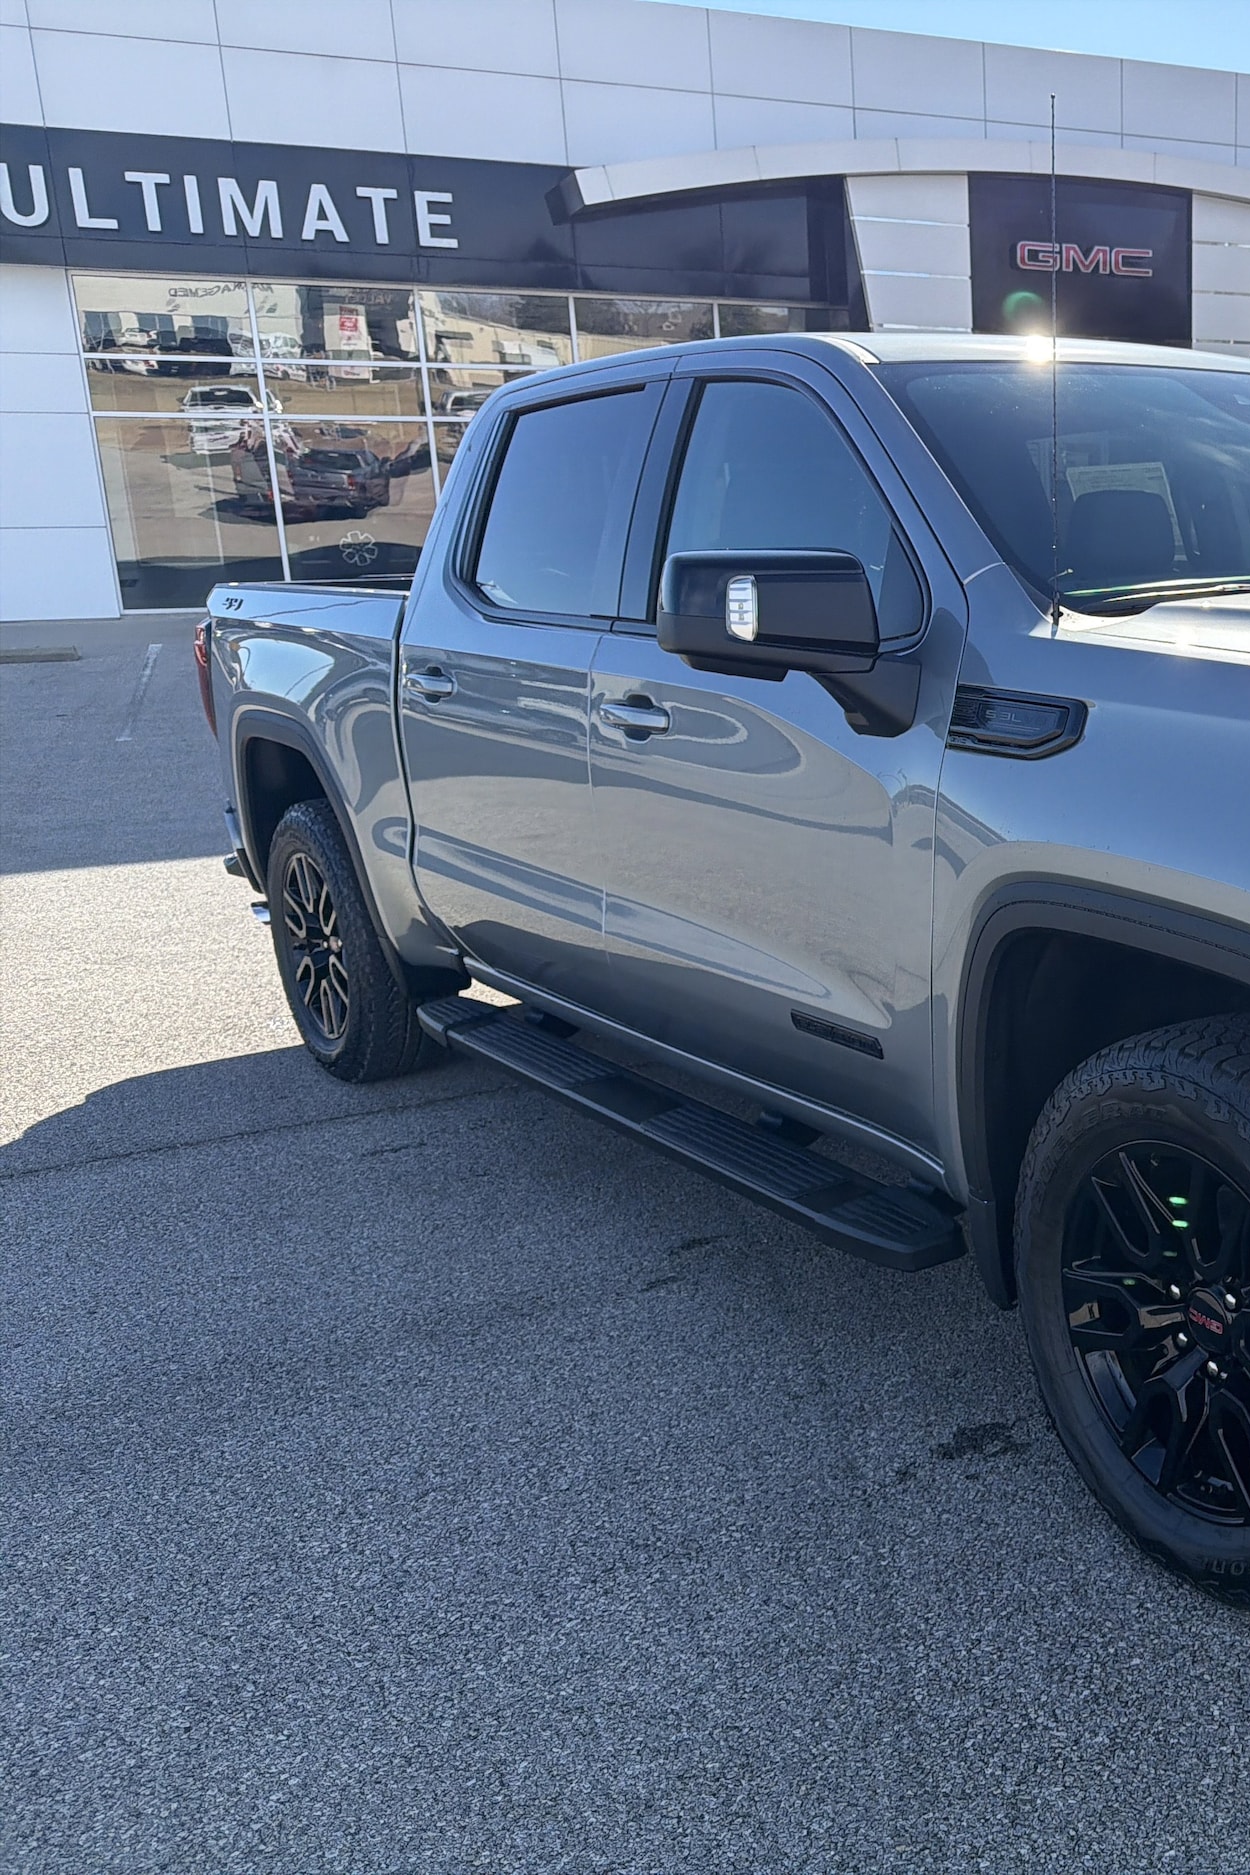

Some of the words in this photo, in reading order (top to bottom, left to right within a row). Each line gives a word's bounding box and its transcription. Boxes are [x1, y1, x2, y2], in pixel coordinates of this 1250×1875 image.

[0, 162, 459, 249] ULTIMATE
[1017, 240, 1153, 277] GMC
[1189, 1306, 1224, 1335] GMC
